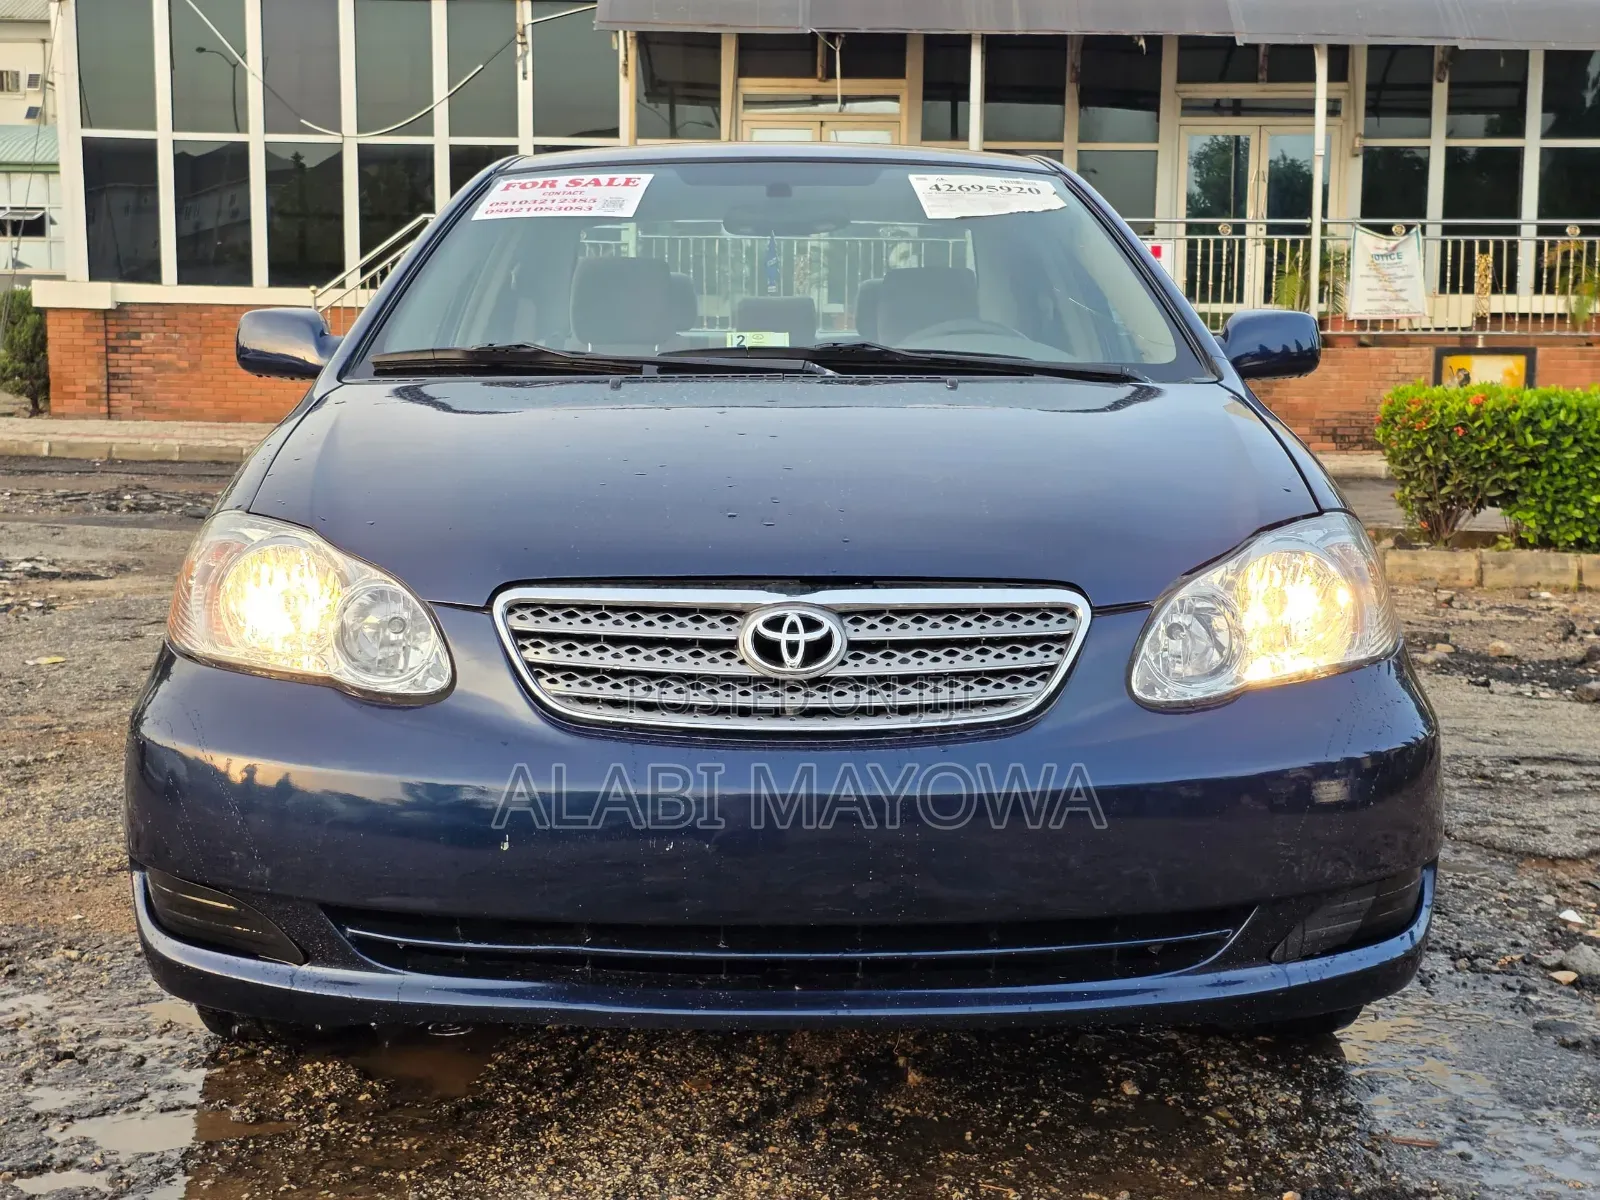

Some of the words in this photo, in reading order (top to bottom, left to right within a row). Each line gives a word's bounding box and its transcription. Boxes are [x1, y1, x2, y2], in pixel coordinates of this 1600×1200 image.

[500, 179, 559, 192] FOR
[565, 177, 641, 188] SALE
[928, 183, 1041, 195] 42695920
[488, 197, 598, 207] 08103212385
[484, 205, 594, 215] 08021083083
